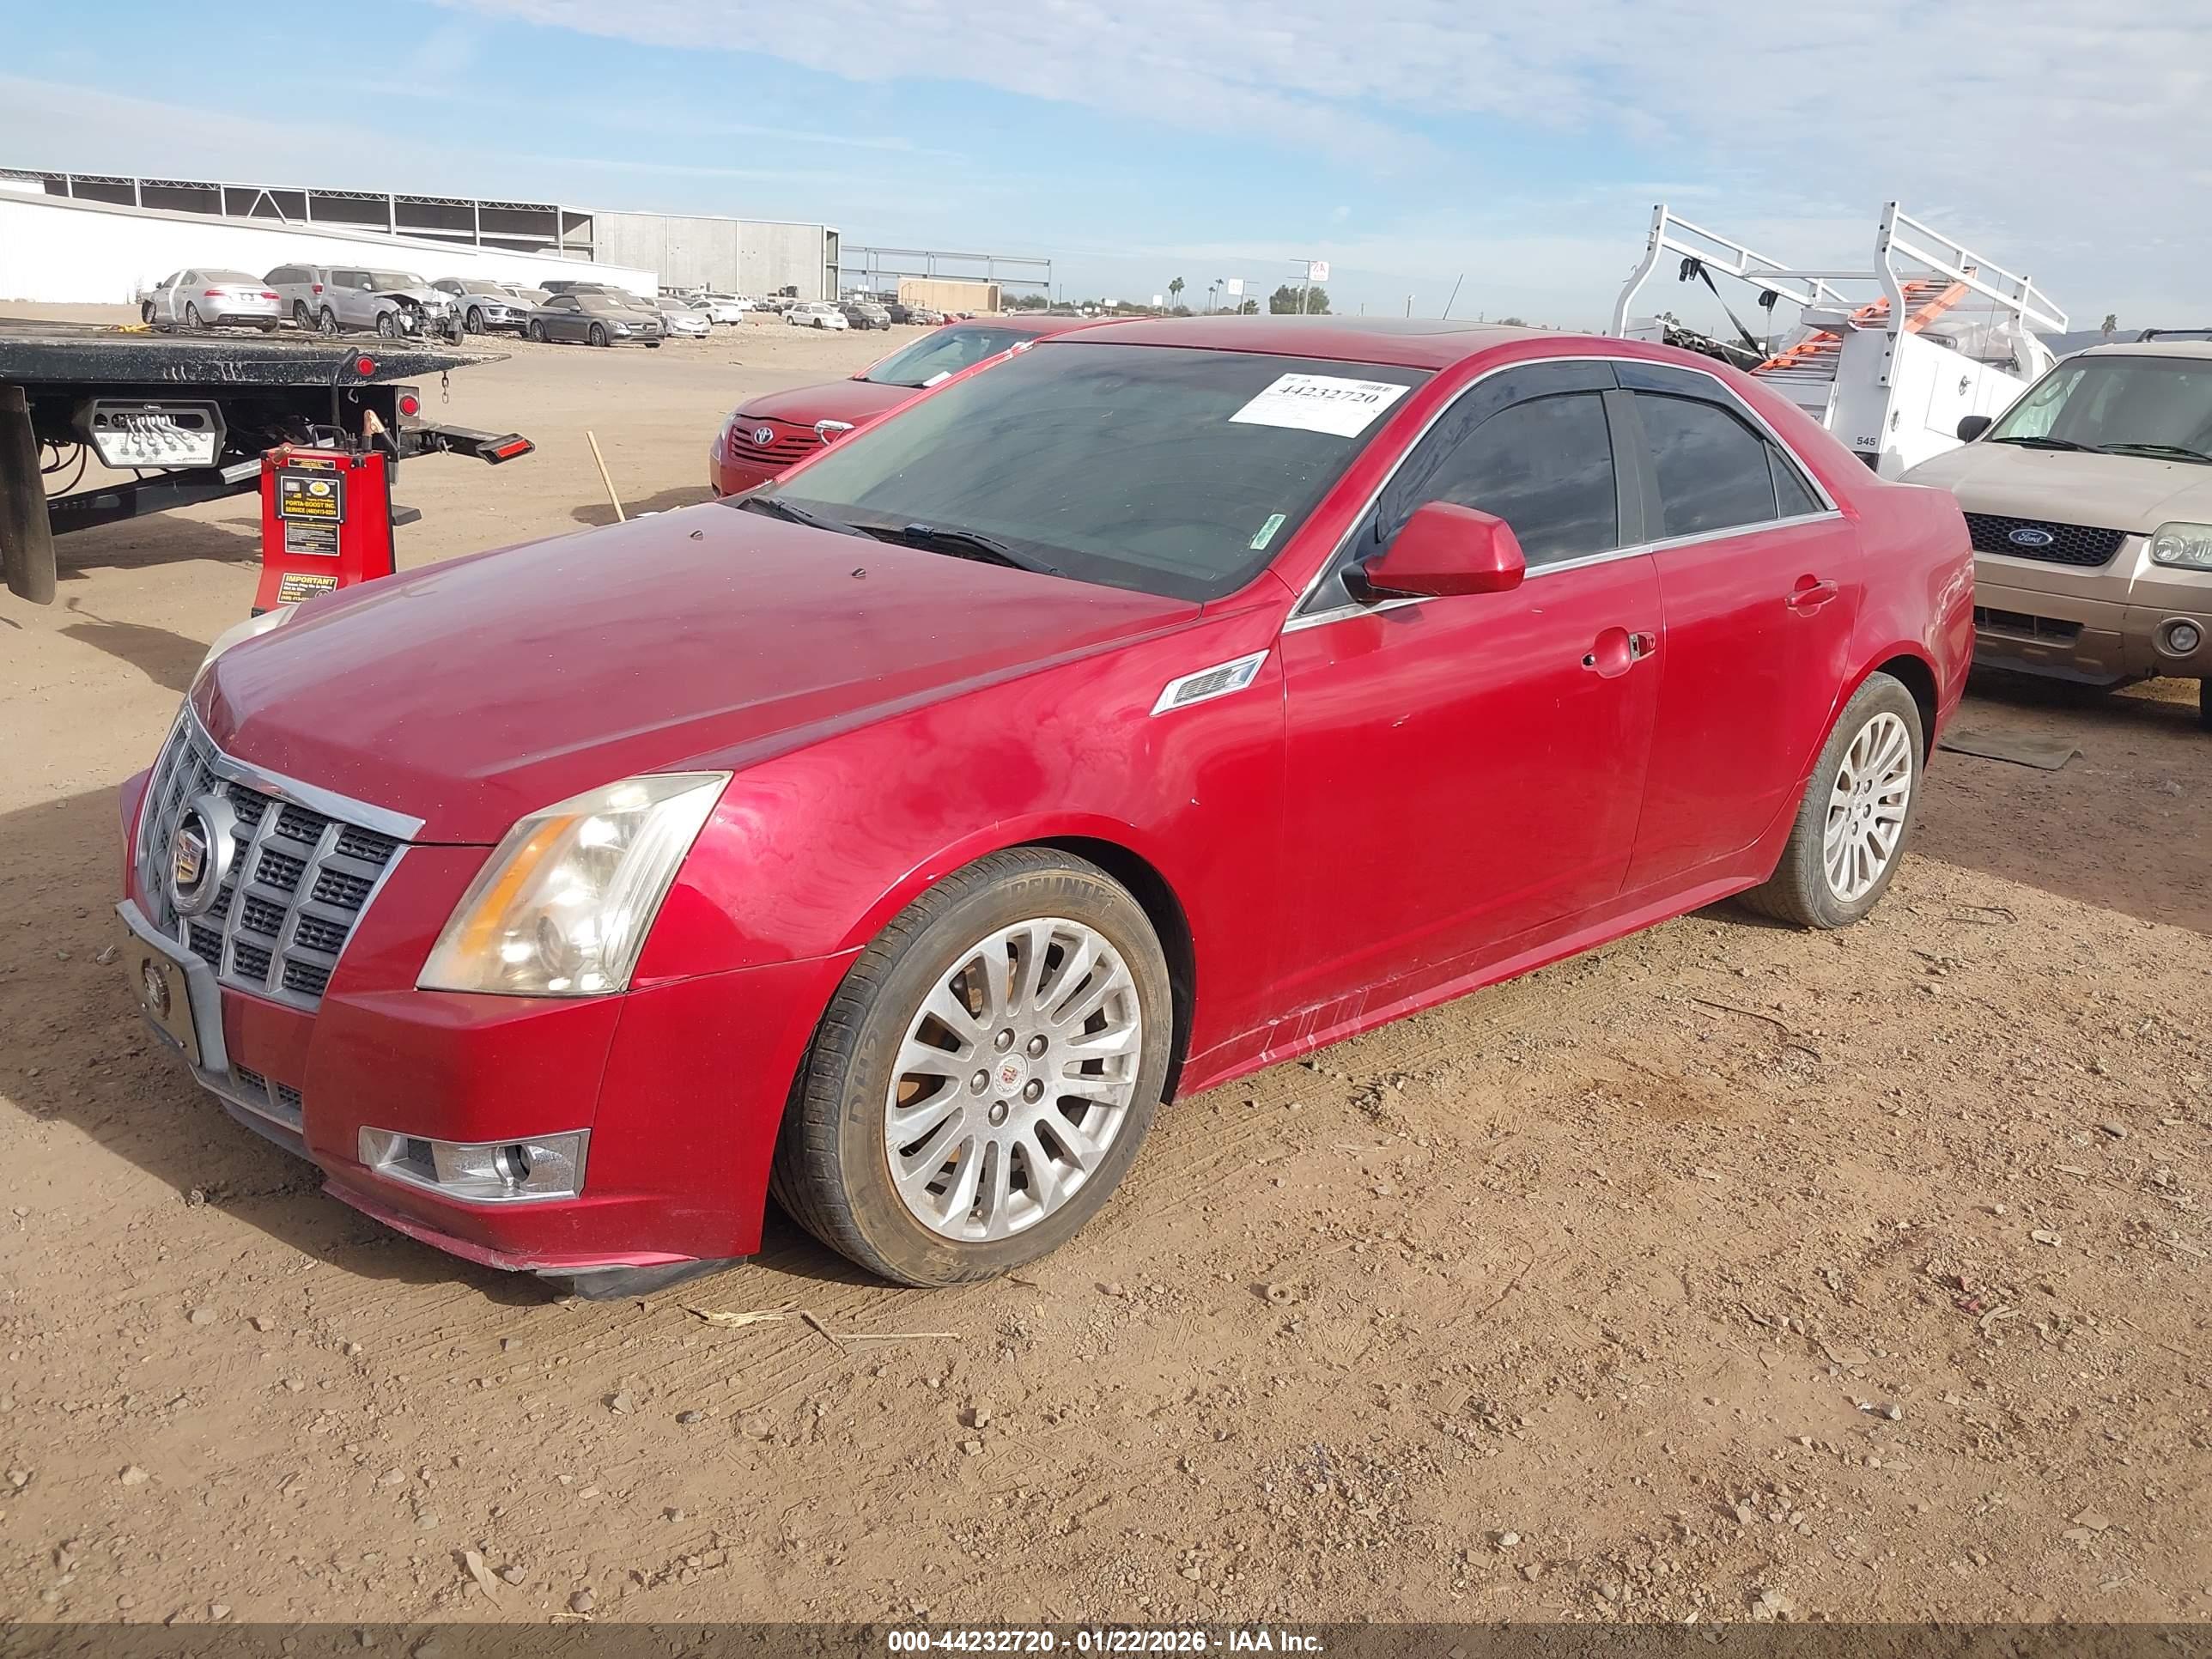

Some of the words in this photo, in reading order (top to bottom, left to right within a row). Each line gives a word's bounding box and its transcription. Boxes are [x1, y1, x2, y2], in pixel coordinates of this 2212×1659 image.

[1279, 385, 1379, 404] 44232720
[1856, 436, 1876, 447] 545
[285, 500, 325, 508] PORTA-BOOST
[2018, 532, 2043, 544] Ford
[285, 575, 335, 586] IMPORTANT
